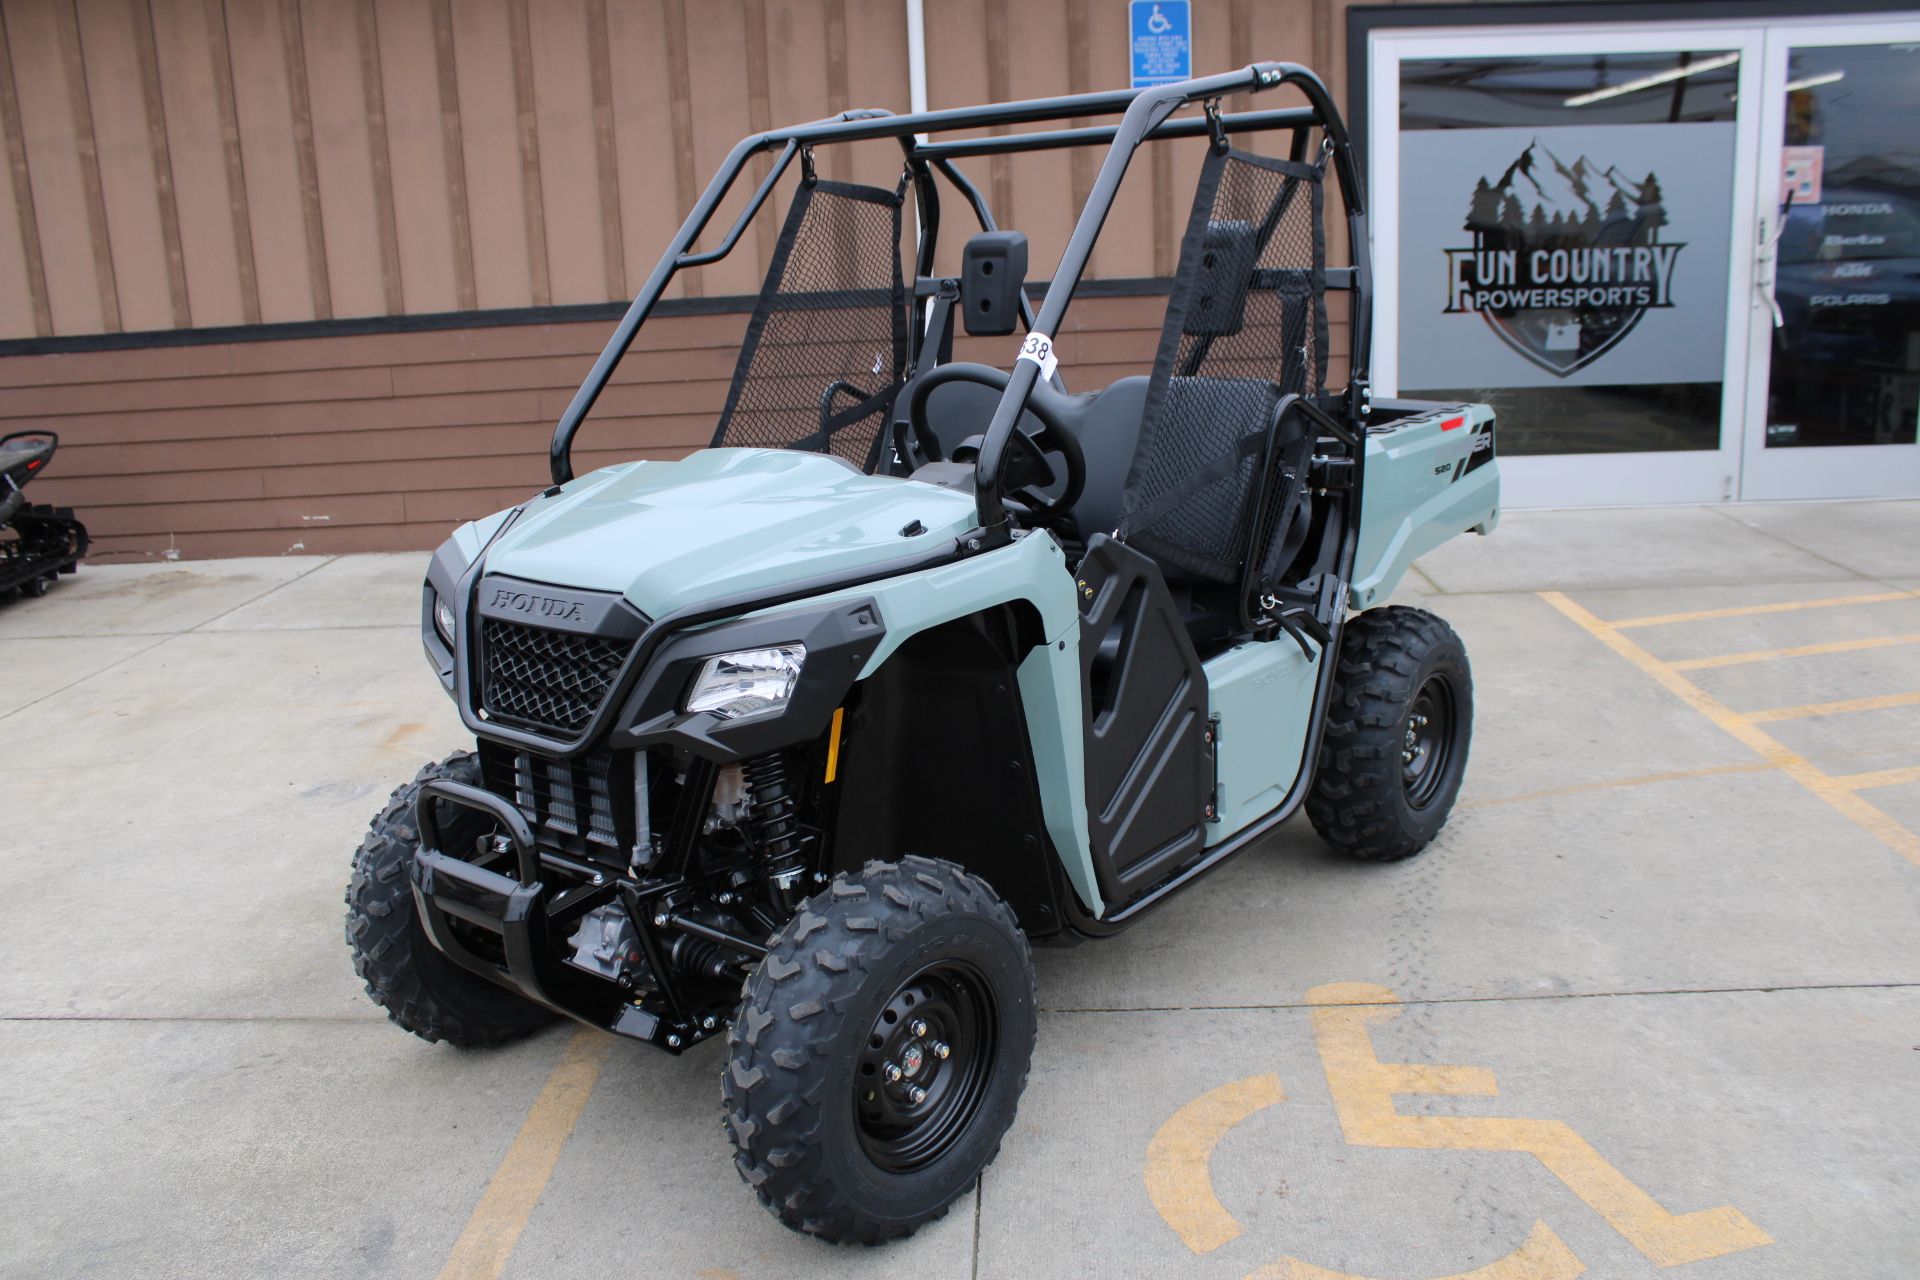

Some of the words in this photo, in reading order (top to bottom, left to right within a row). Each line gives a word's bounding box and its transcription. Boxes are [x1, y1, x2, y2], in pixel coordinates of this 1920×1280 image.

[1821, 203, 1893, 216] HONDA
[1446, 249, 1517, 312] FUN
[1531, 245, 1682, 307] COUNTRY
[1475, 286, 1651, 309] POWERSPORTS
[1809, 293, 1891, 306] POLARIS
[490, 589, 586, 623] HONDA
